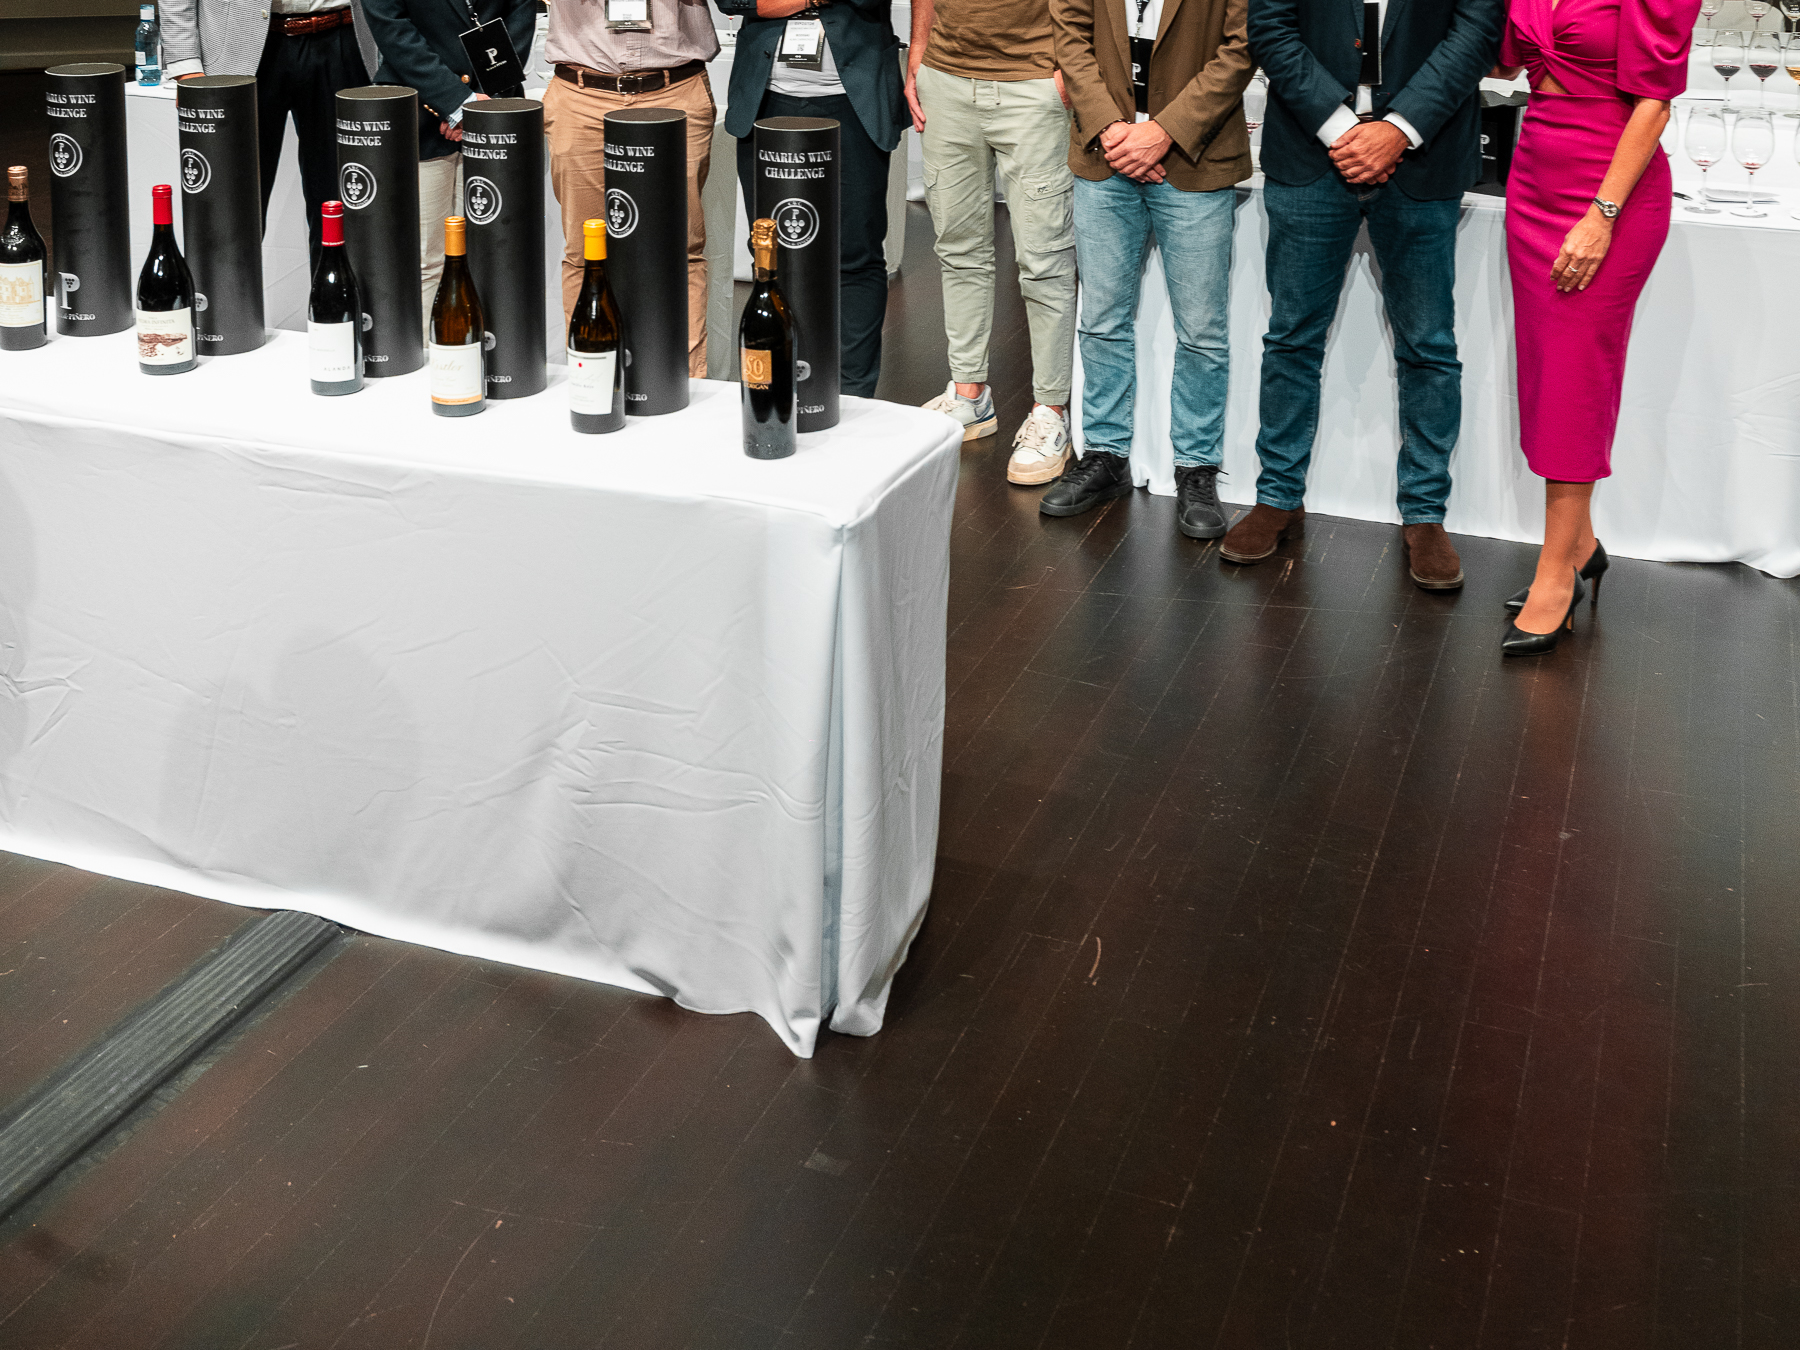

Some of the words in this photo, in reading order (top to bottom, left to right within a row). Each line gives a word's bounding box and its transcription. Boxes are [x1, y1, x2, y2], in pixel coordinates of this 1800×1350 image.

[69, 94, 96, 103] WINE
[198, 109, 225, 118] WINE
[363, 121, 391, 131] WINE
[488, 134, 517, 144] WINE
[626, 146, 654, 156] WINE
[759, 150, 805, 163] CANARIAS
[807, 150, 832, 163] WINE
[765, 167, 825, 179] CHALLENGE
